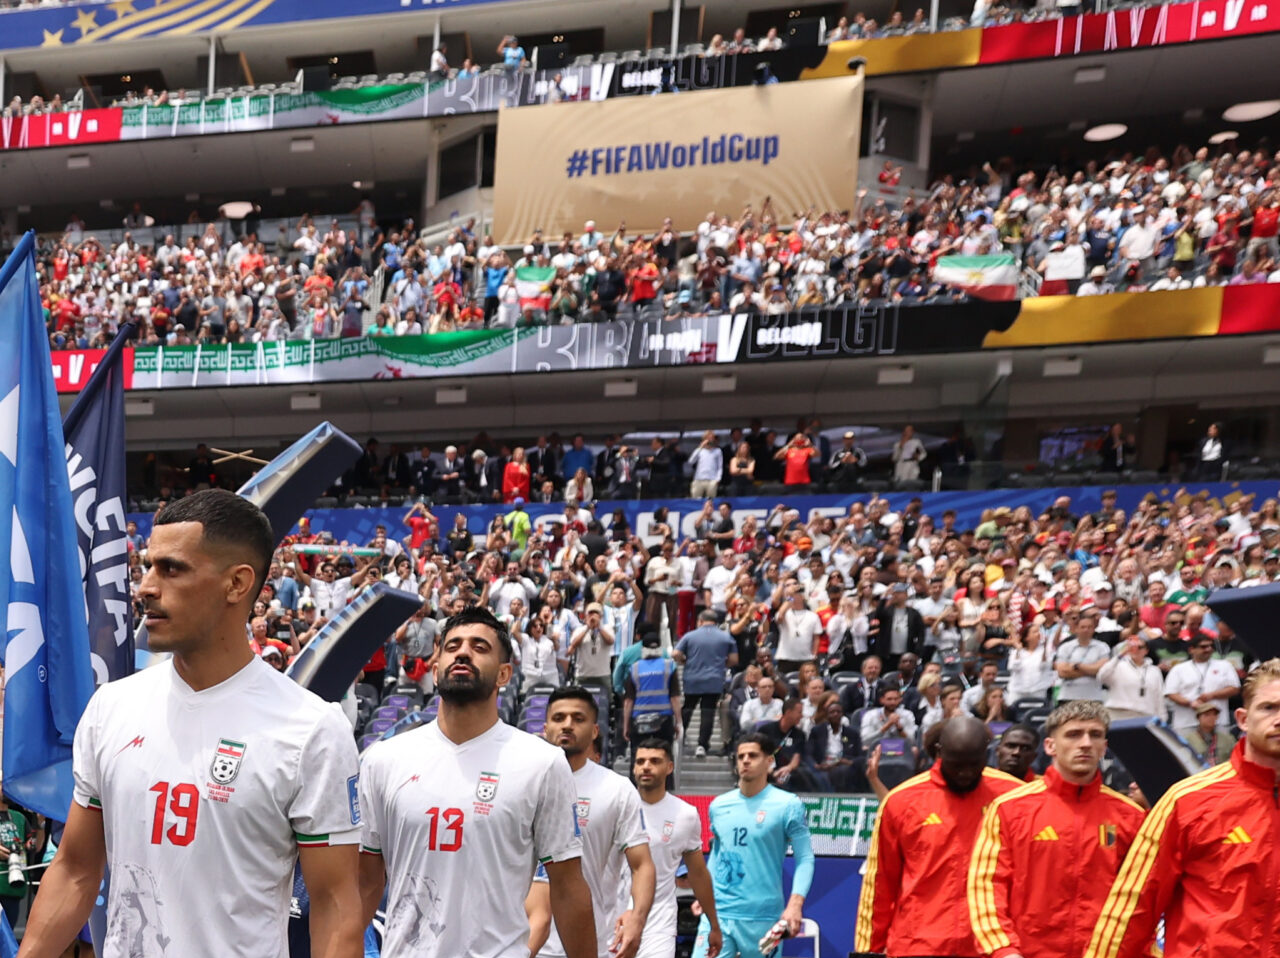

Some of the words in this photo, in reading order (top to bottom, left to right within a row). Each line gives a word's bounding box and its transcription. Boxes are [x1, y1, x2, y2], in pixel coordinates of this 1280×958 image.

[566, 132, 780, 178] #FIFAWorldCup
[150, 781, 200, 847] 19
[426, 806, 465, 852] 13
[732, 826, 749, 847] 12
